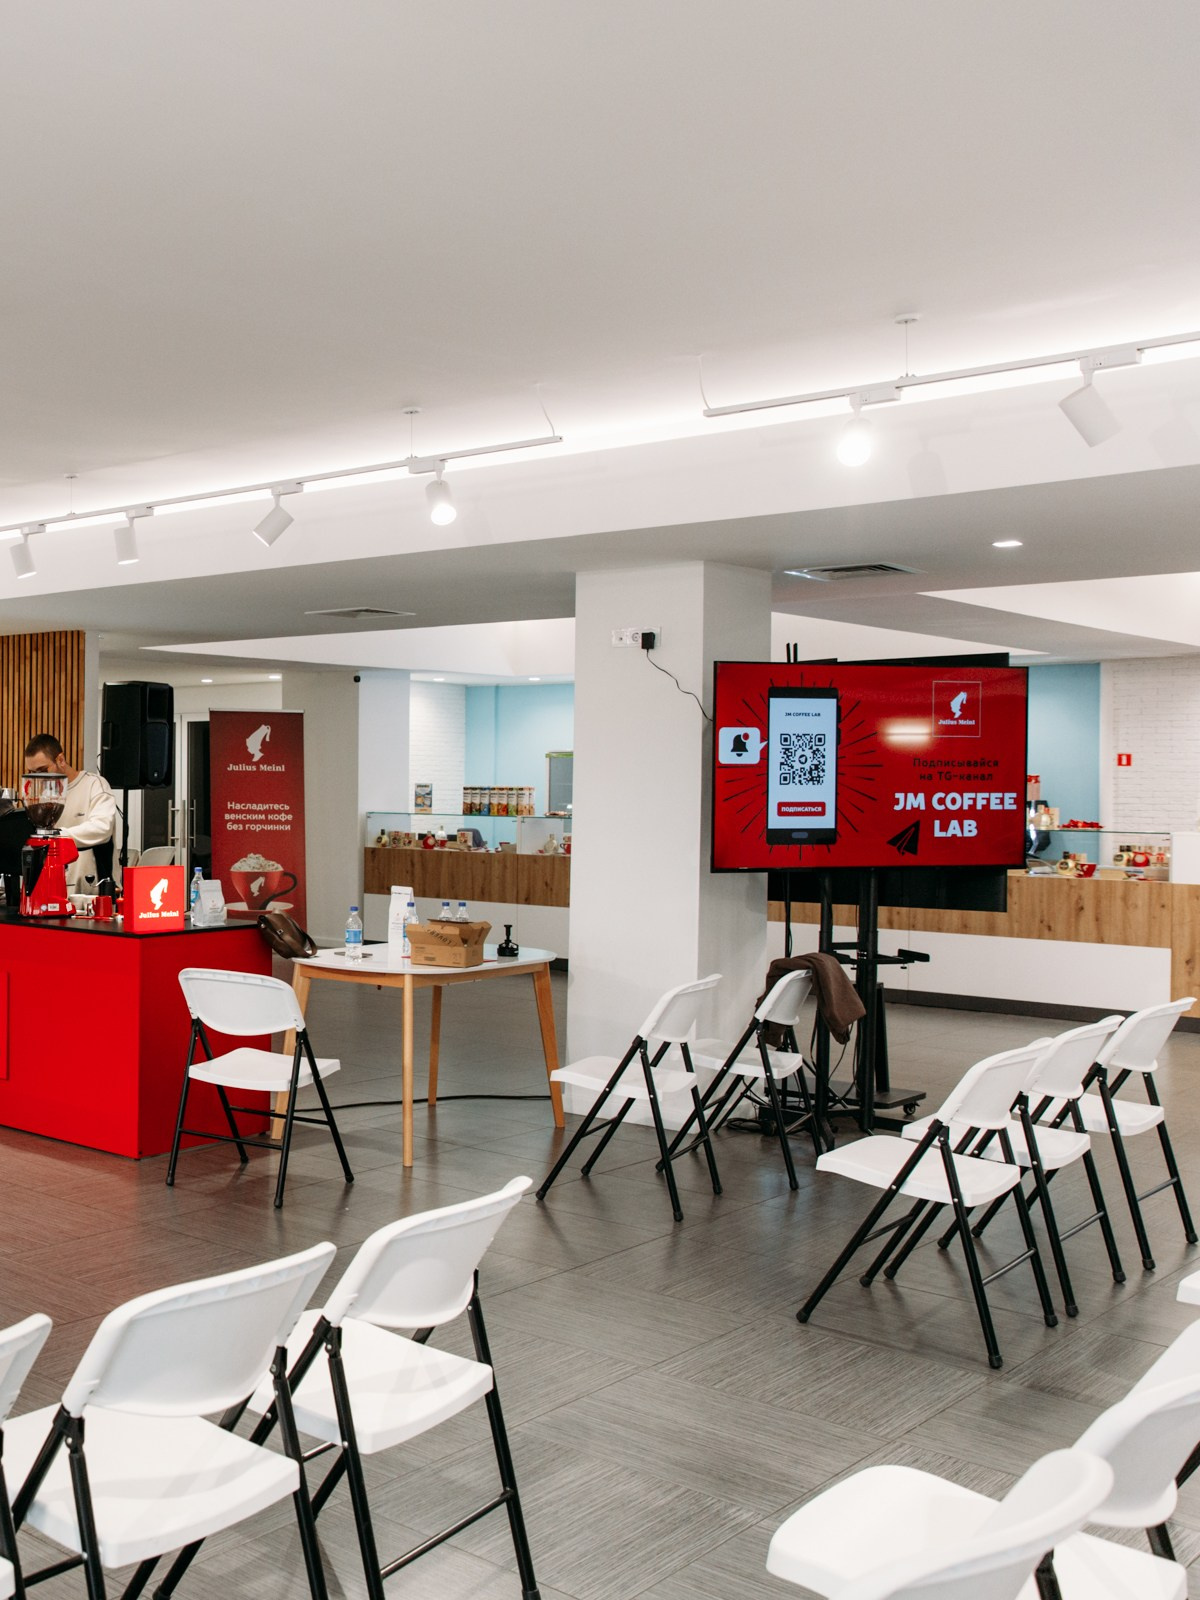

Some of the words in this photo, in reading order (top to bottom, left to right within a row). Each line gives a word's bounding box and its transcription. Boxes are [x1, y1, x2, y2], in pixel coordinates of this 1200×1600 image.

[227, 763, 256, 771] Julius
[259, 764, 285, 772] Meinl
[913, 758, 999, 768] Подписывайся
[937, 772, 993, 781] TG-канал
[228, 801, 289, 811] Насладитесь
[894, 792, 926, 811] JM
[932, 792, 1017, 811] COFFEE
[224, 813, 266, 821] венским
[268, 812, 293, 822] кофе
[226, 822, 243, 831] без
[245, 823, 291, 832] горчинки
[934, 820, 977, 838] LAB
[139, 911, 159, 919] Julius
